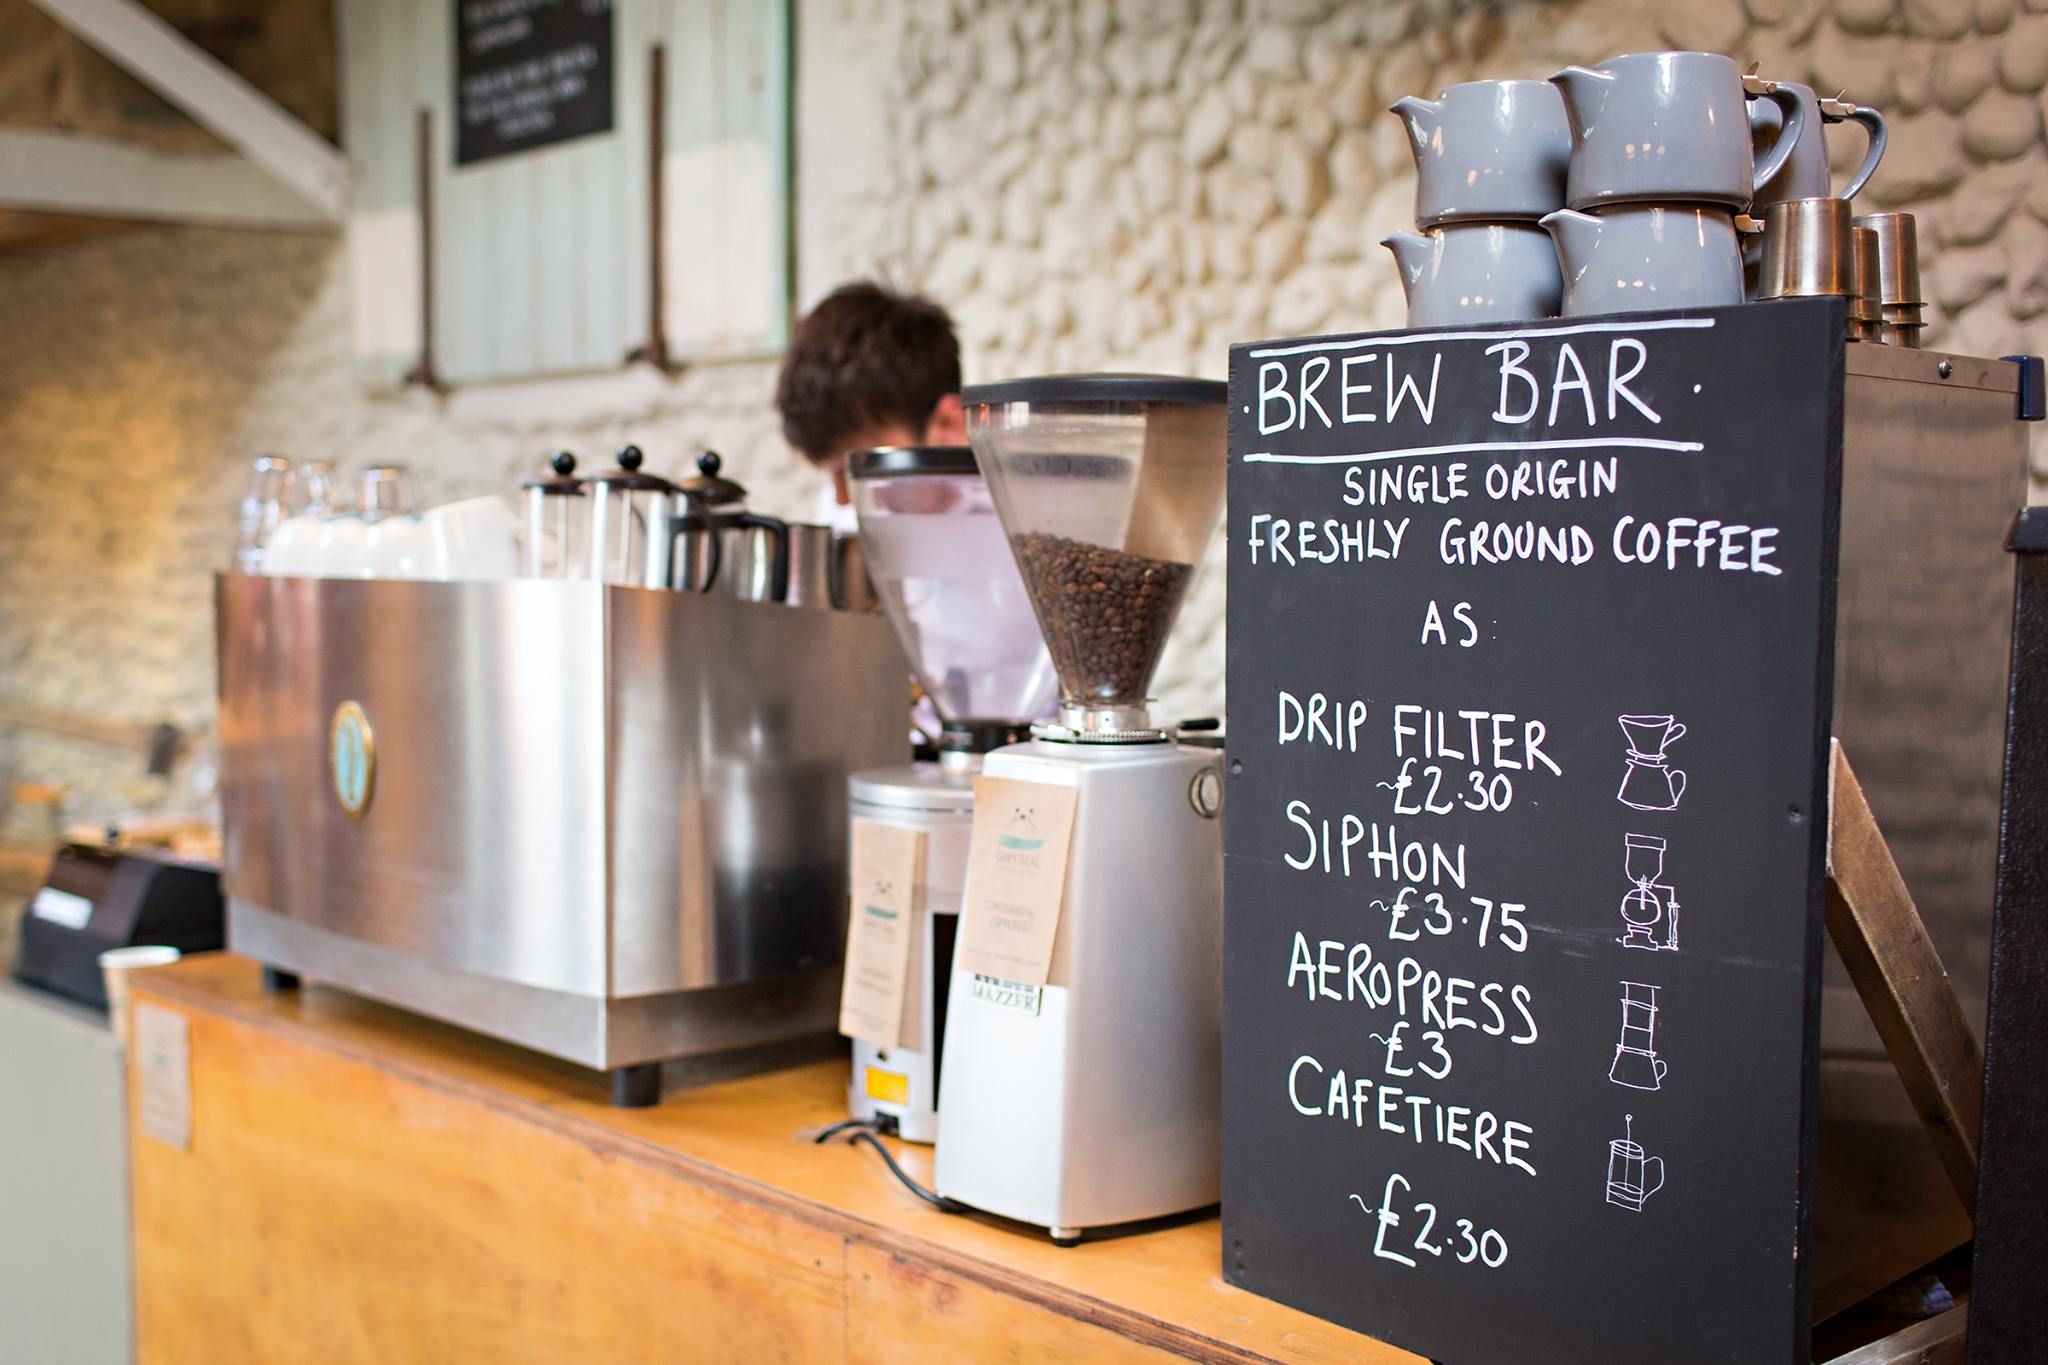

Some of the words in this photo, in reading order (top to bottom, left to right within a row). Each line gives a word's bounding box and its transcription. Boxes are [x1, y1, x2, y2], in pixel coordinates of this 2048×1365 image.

[1258, 352, 1442, 436] BREW
[1484, 338, 1662, 427] BAR
[1342, 462, 1469, 506] SINGLE
[1485, 456, 1618, 502] ORIGIN
[1248, 513, 1411, 567] FRESHLY
[1439, 517, 1594, 566] GROUND
[1612, 515, 1783, 576] COFFEE
[1278, 690, 1368, 753] DRIP
[1393, 704, 1563, 777] FILTER
[1283, 799, 1466, 890] SIPHON
[1287, 930, 1538, 1045] AEROPRESS
[1288, 1055, 1537, 1177] CAFETIERE
